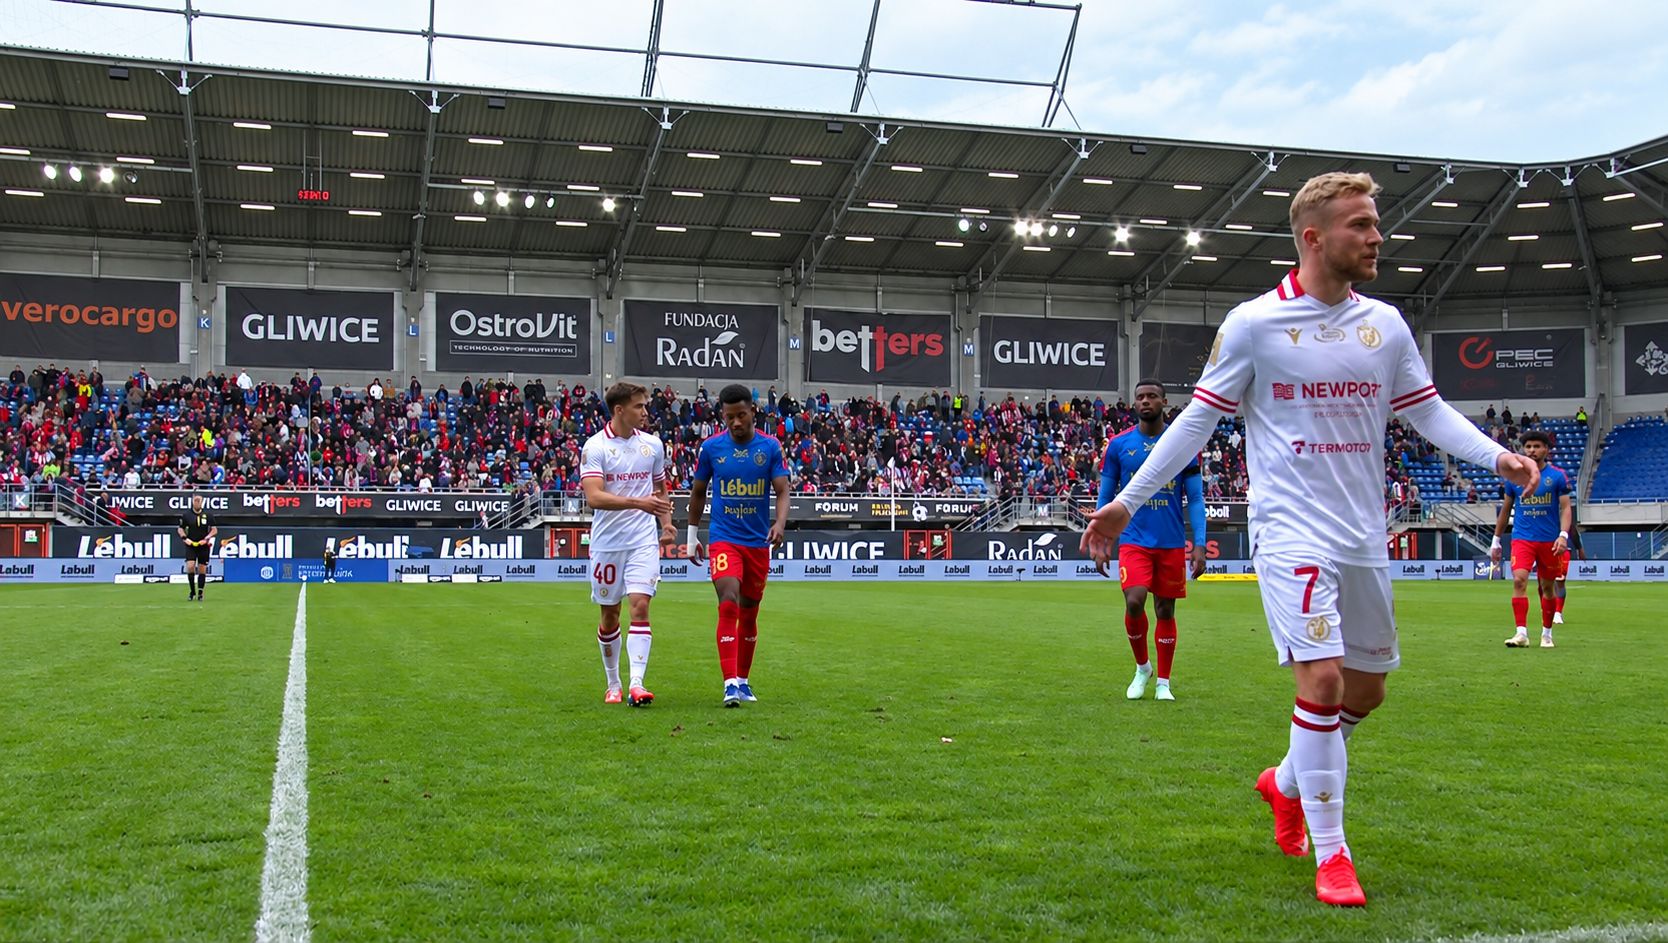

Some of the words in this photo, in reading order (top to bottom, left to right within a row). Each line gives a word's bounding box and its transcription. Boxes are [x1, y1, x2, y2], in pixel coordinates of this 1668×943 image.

[1, 301, 178, 334] verocargo
[200, 318, 209, 328] K
[450, 309, 577, 339] OstroVit
[664, 312, 739, 330] FUNDACJA
[242, 313, 379, 343] GLIWICE
[409, 325, 416, 336] L
[605, 332, 612, 343] L
[789, 339, 800, 349] M
[454, 344, 510, 352] TECHNOLOGY
[812, 319, 944, 373] betters
[964, 344, 974, 355] M
[993, 340, 1106, 367] GLIWICE
[1496, 348, 1553, 361] PEC
[1496, 361, 1553, 369] GLIWICE
[243, 493, 300, 514] betters
[315, 494, 372, 515] betters
[386, 499, 441, 511] GLIWICE
[815, 502, 859, 512] FORUM
[593, 562, 616, 585] 40
[1294, 566, 1320, 614] 7
